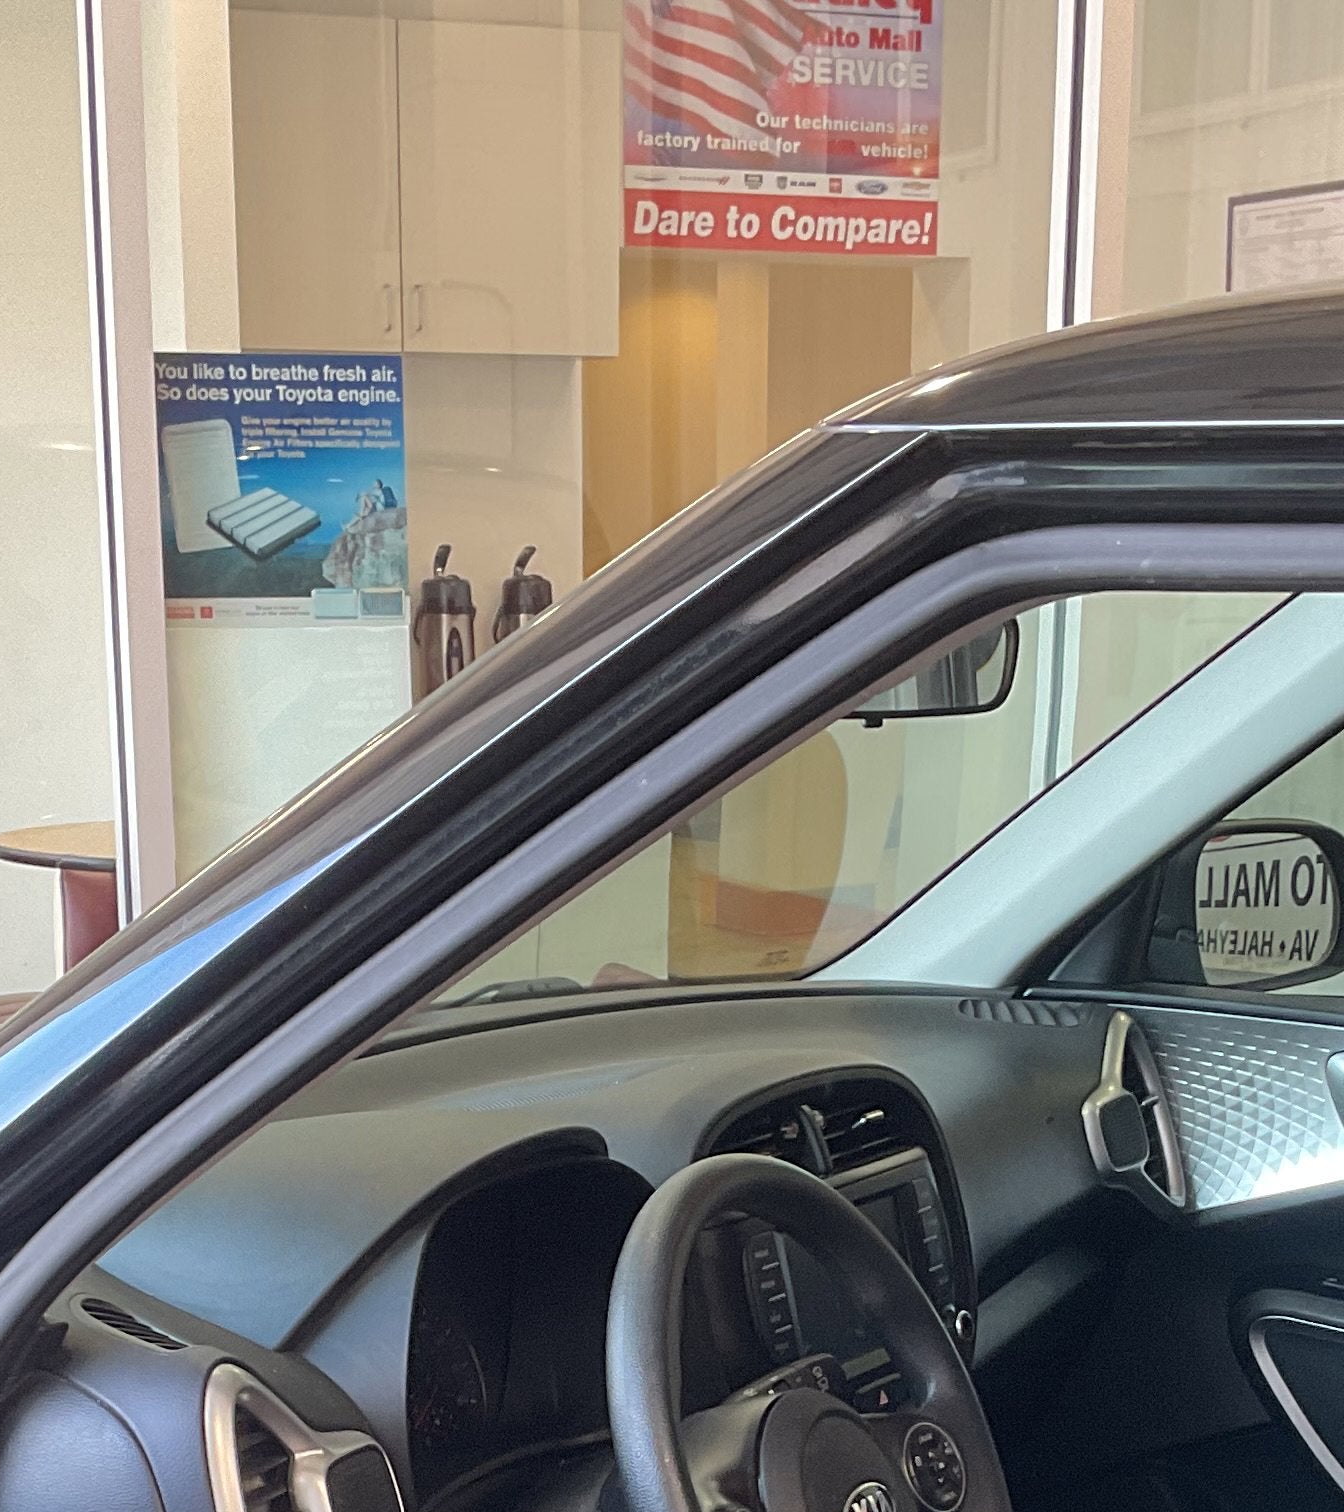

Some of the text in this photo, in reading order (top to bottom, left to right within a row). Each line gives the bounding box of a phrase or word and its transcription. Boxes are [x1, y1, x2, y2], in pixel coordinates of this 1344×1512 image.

[869, 27, 922, 52] Mall
[792, 55, 929, 89] SERVICE
[756, 112, 929, 135] Our technicians are
[637, 131, 800, 154] factory trained for
[861, 143, 929, 160] vehicle!
[634, 200, 933, 249] Dare to Compare!
[156, 363, 397, 383] You like to breathe fresh air.
[157, 384, 401, 406] So does your Toyota engine.
